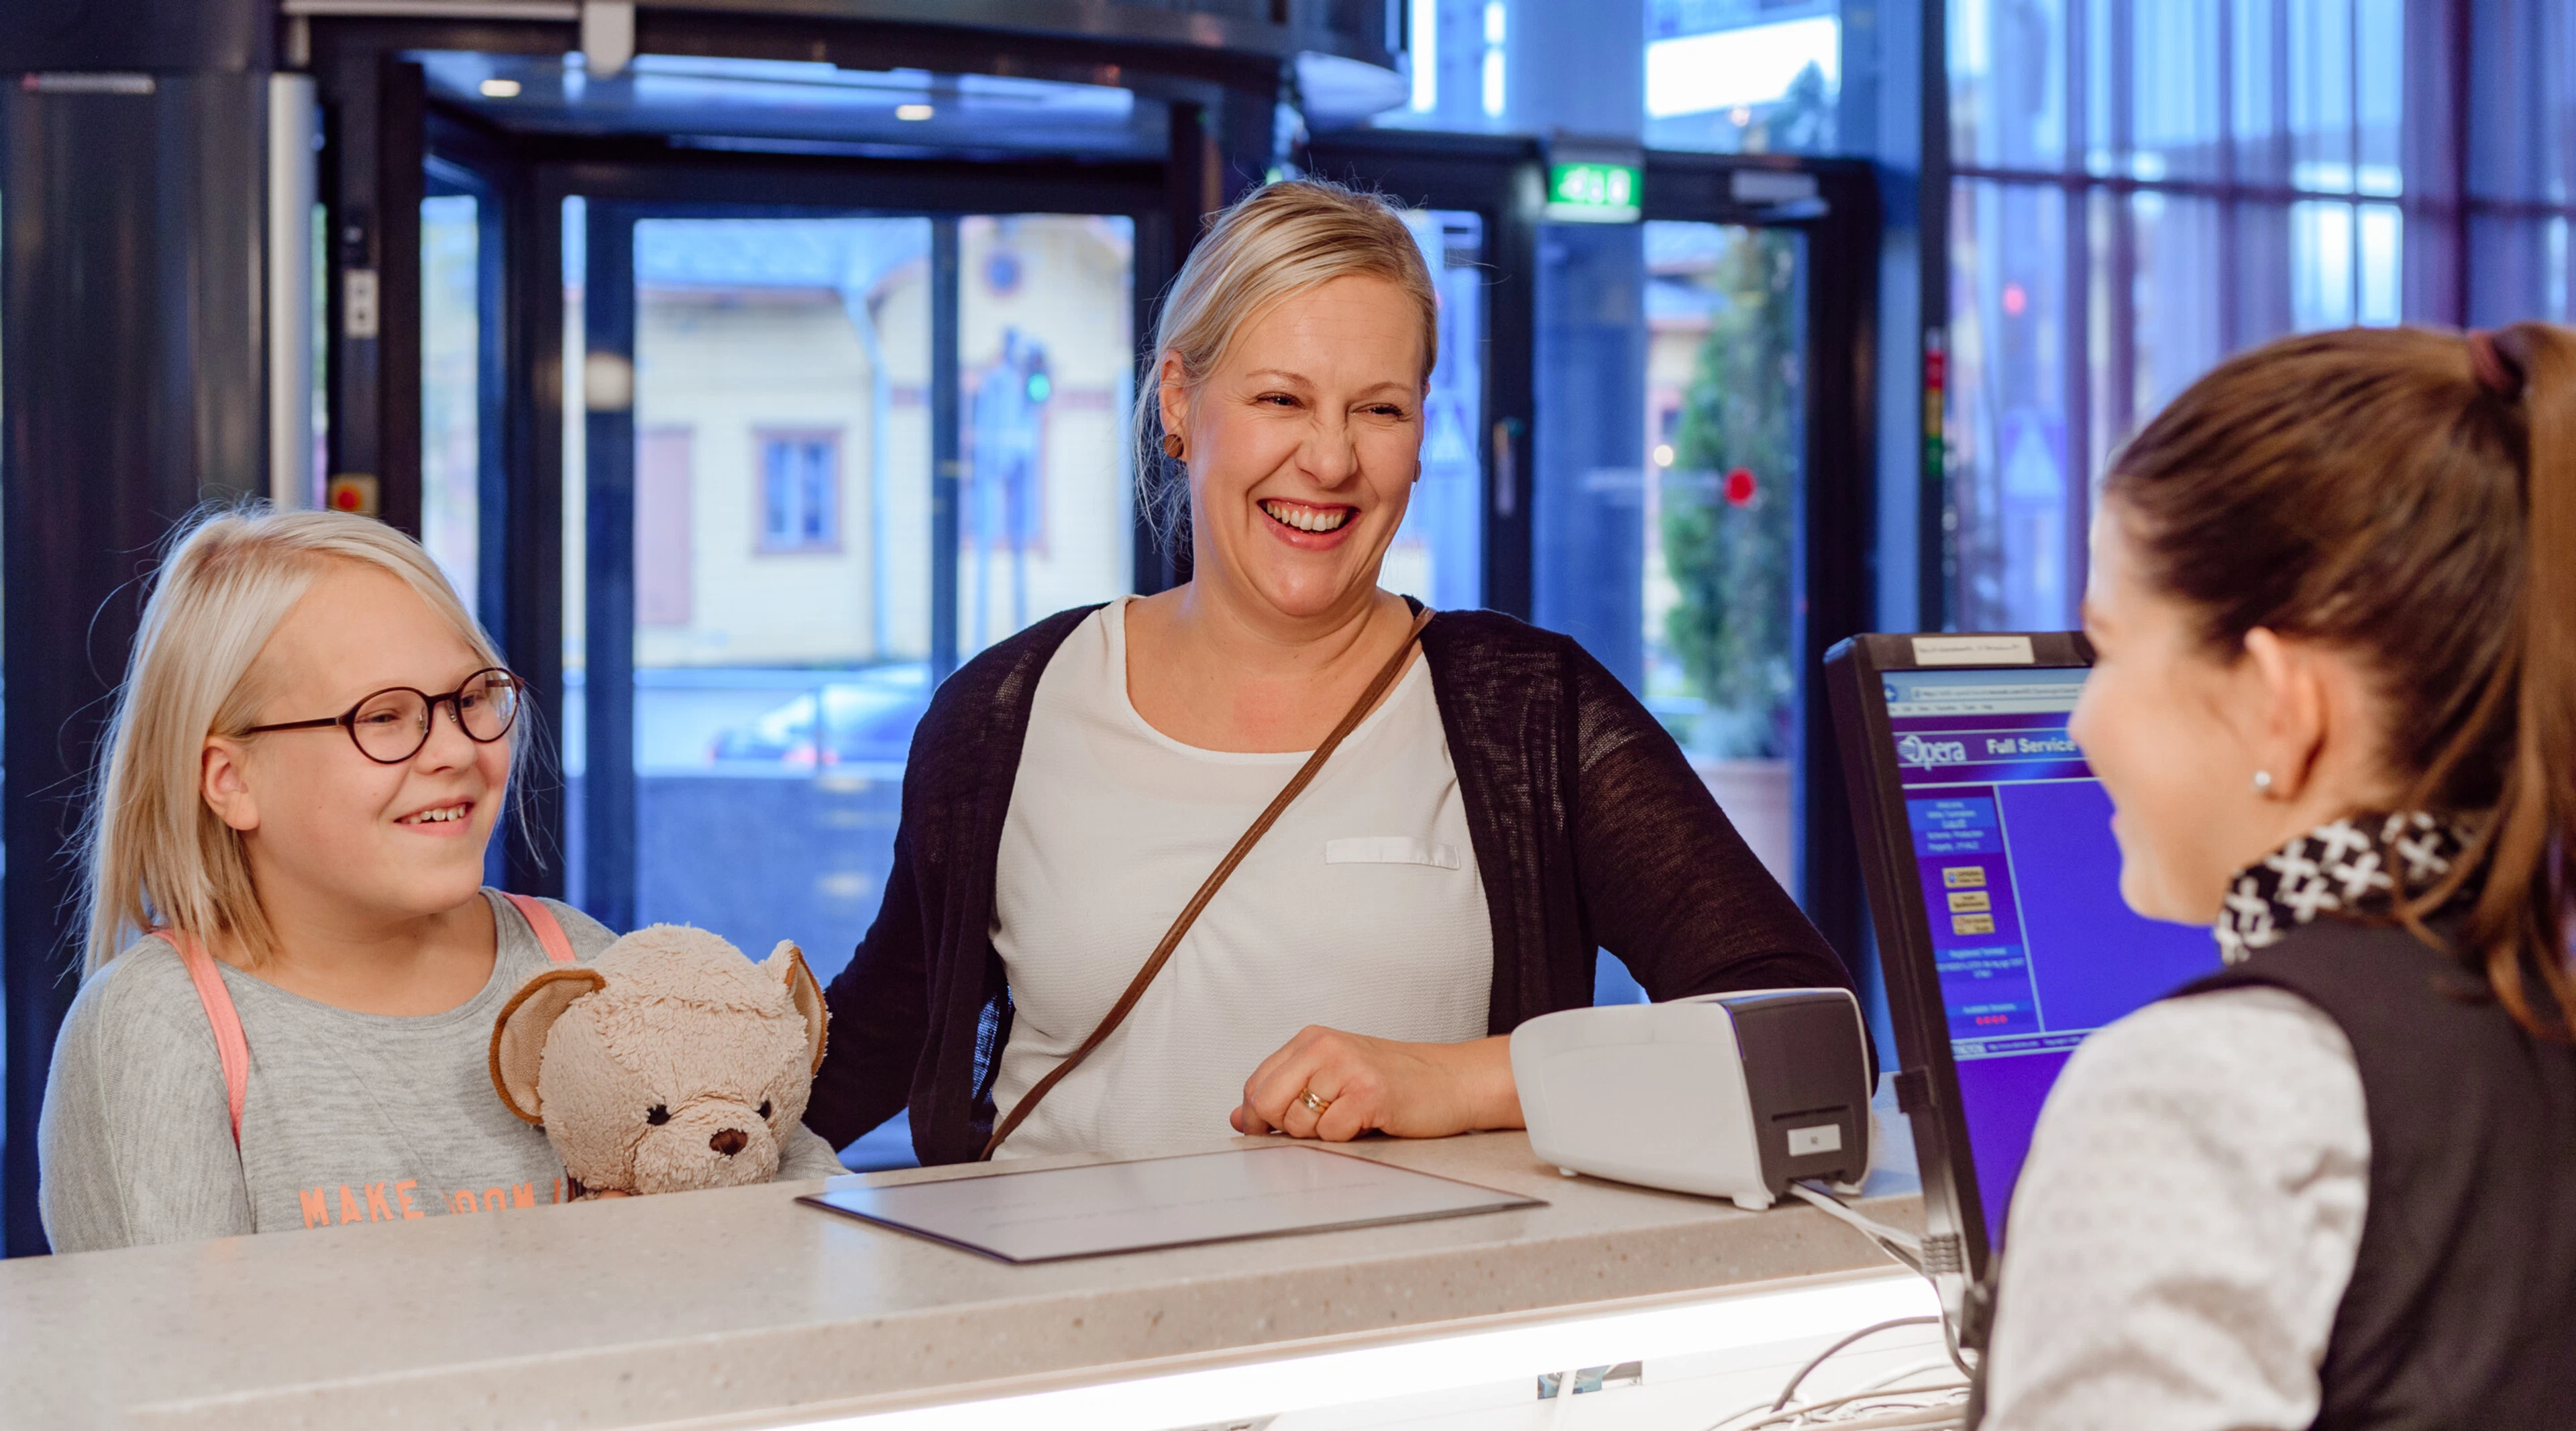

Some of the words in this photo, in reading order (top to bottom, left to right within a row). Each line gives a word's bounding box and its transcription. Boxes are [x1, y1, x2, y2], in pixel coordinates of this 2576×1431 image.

[1897, 734, 1967, 772] Opera
[1986, 738, 2016, 754] Full
[2018, 737, 2077, 753] Service
[299, 1179, 425, 1229] MAKE
[440, 1181, 535, 1214] OOM
